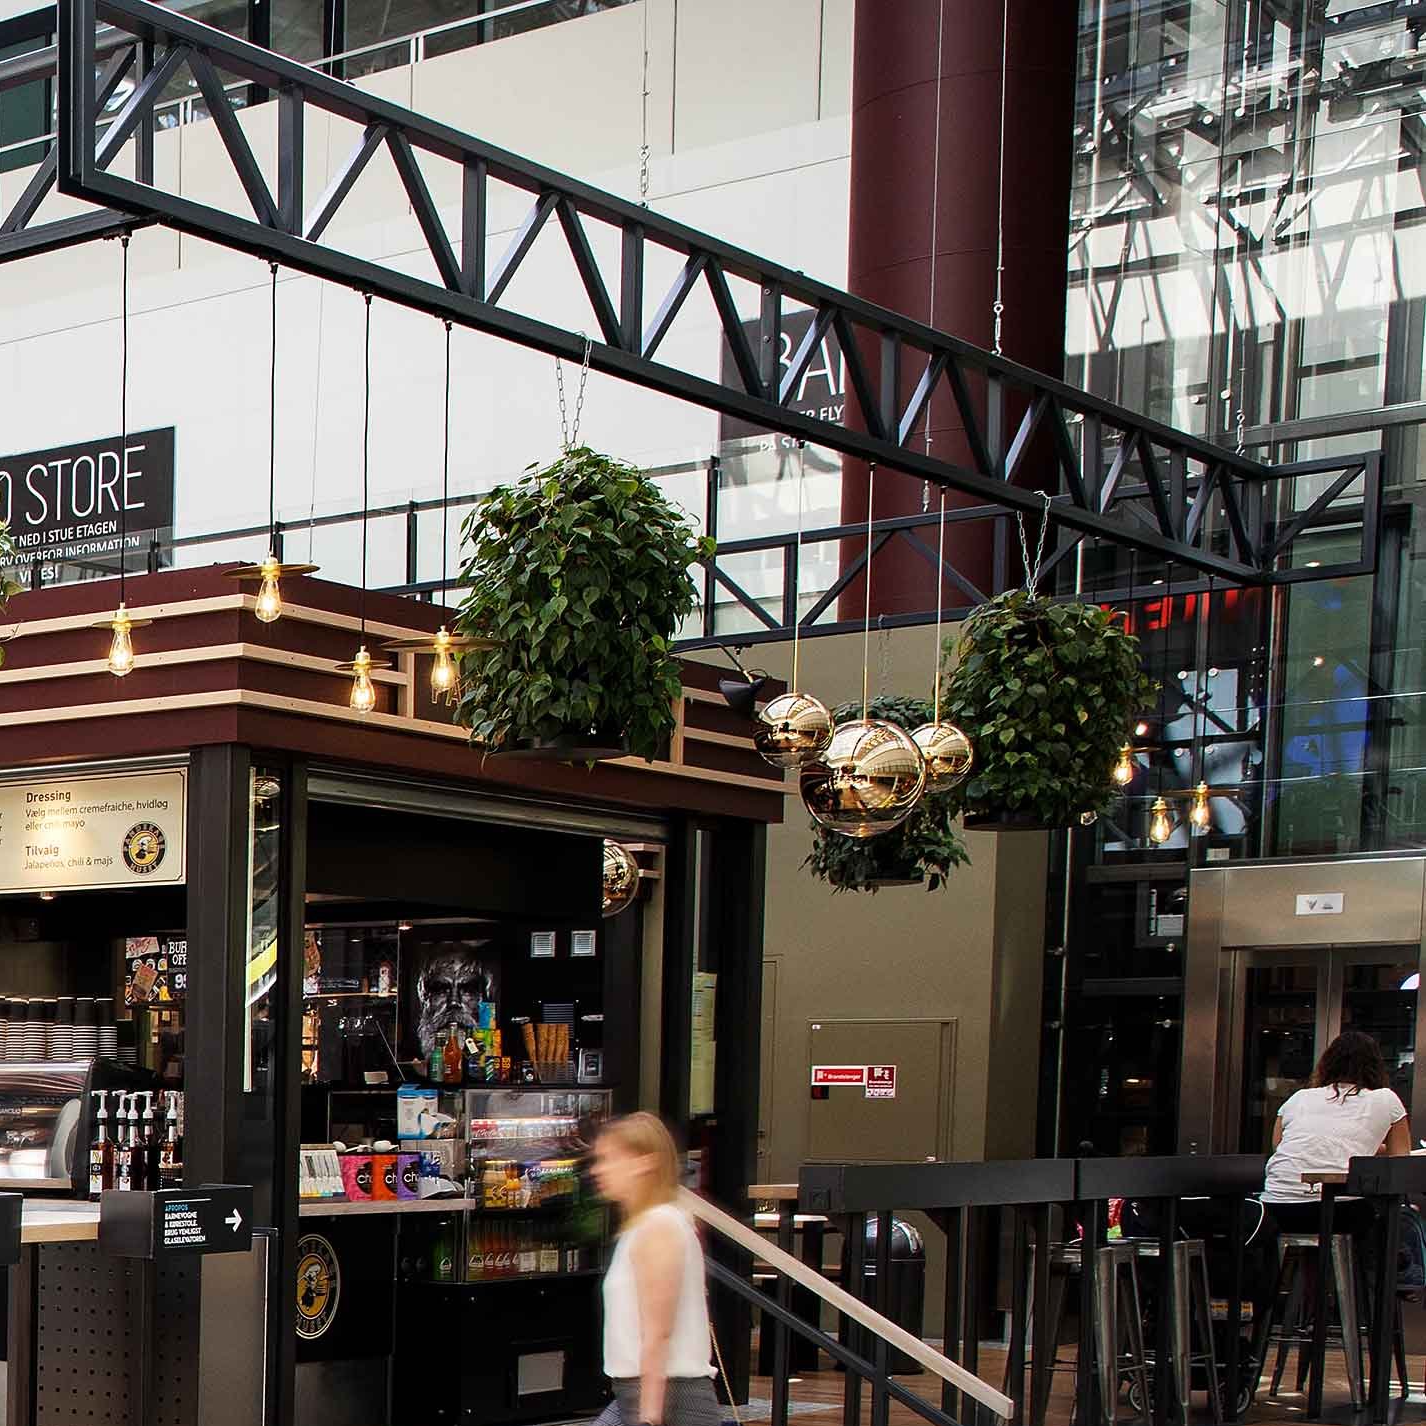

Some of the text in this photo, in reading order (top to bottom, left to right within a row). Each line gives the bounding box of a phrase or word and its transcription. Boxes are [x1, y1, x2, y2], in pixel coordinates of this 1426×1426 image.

[25, 445, 146, 525] STORE
[19, 521, 117, 548] NED STUE ETAGEN
[65, 537, 140, 557] INFORMATION
[26, 790, 71, 804] Dressing
[26, 808, 46, 818] Vælg
[79, 803, 135, 814] cremefraiche,
[136, 800, 168, 809] hvidløg
[25, 845, 59, 857] Tilvalg
[68, 855, 113, 867] chili majs
[169, 941, 187, 954] BUR
[165, 1204, 188, 1212] APROPOS
